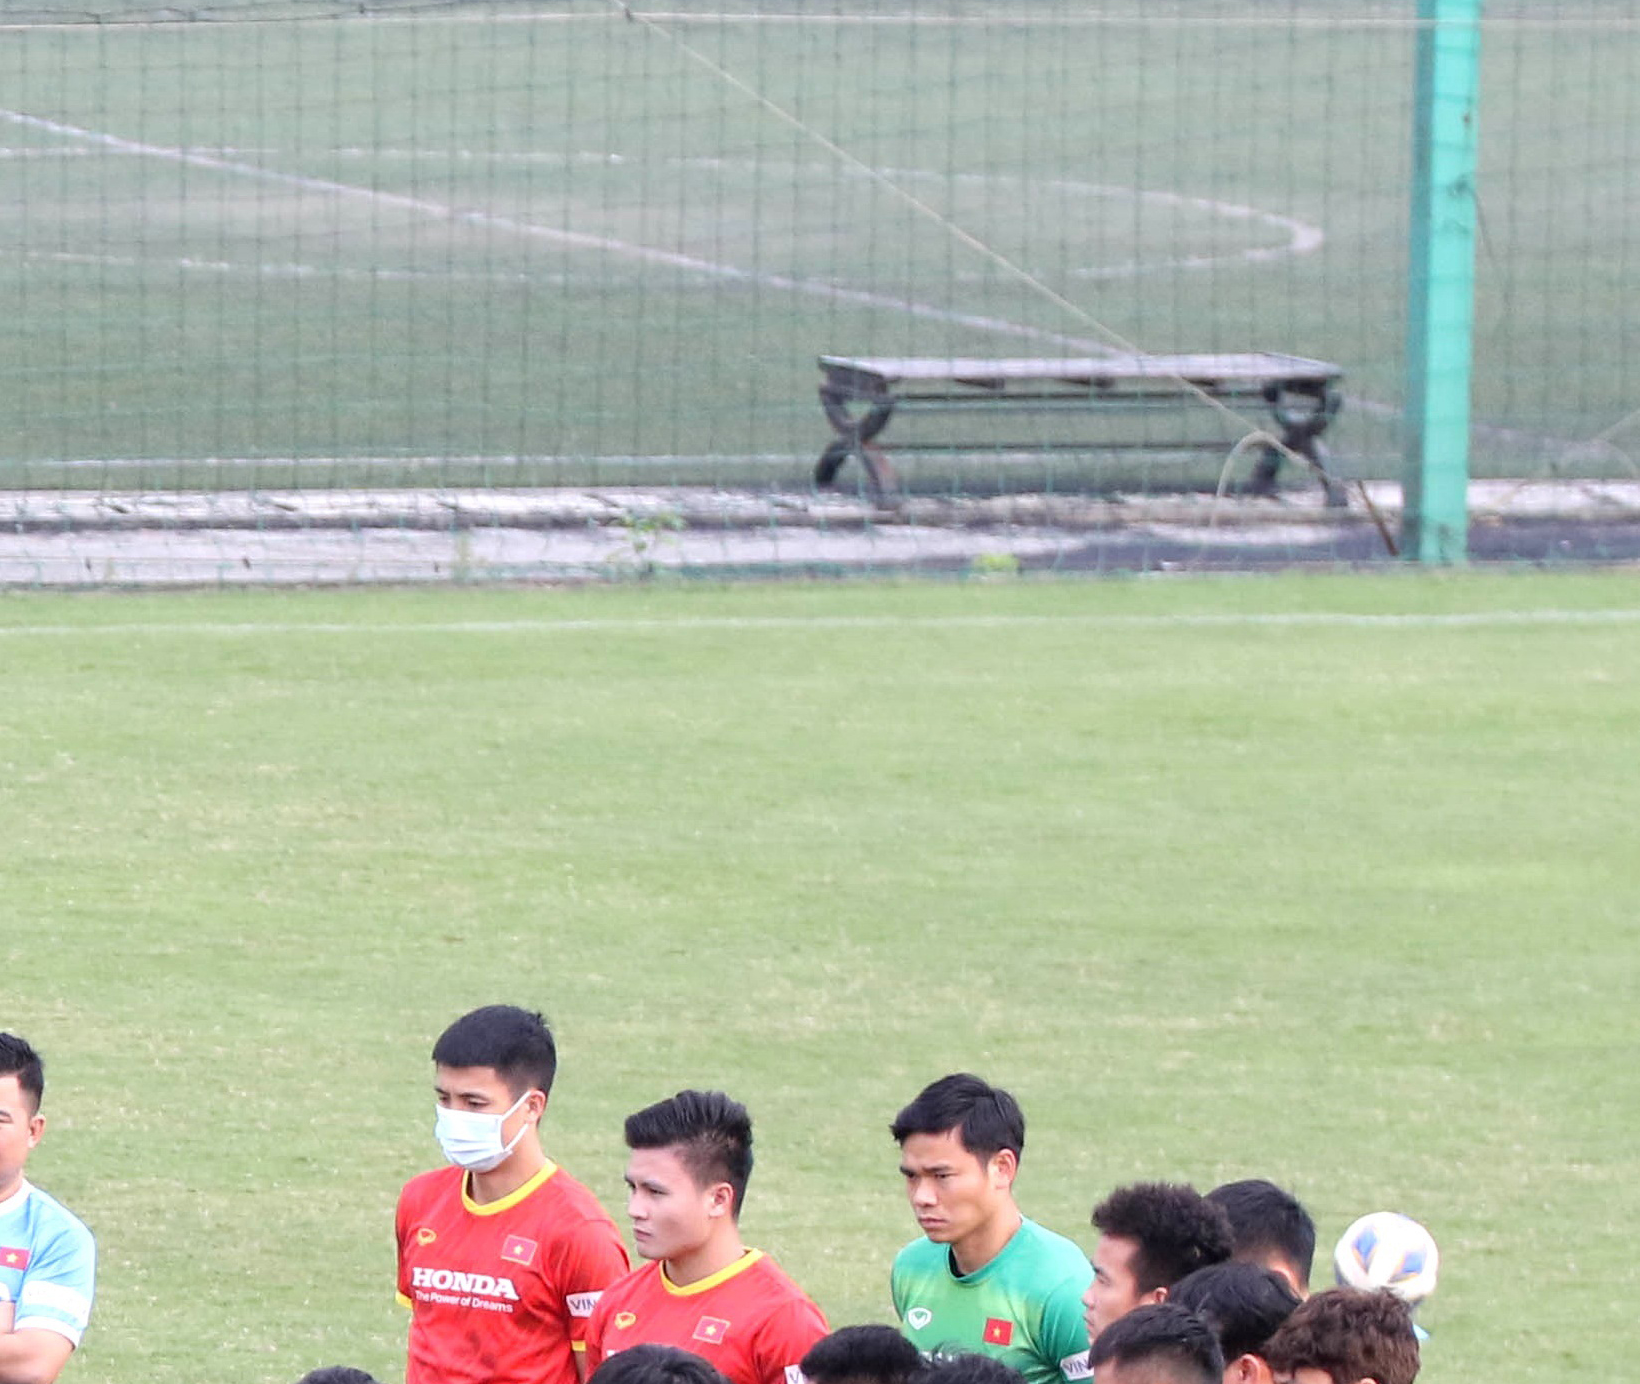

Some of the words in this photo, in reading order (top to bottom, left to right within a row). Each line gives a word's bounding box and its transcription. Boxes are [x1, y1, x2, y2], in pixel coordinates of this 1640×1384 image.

[412, 1267, 519, 1300] HONDA
[415, 1290, 429, 1302] The
[430, 1294, 458, 1308] Power
[460, 1296, 471, 1308] of
[472, 1298, 513, 1314] Dreams
